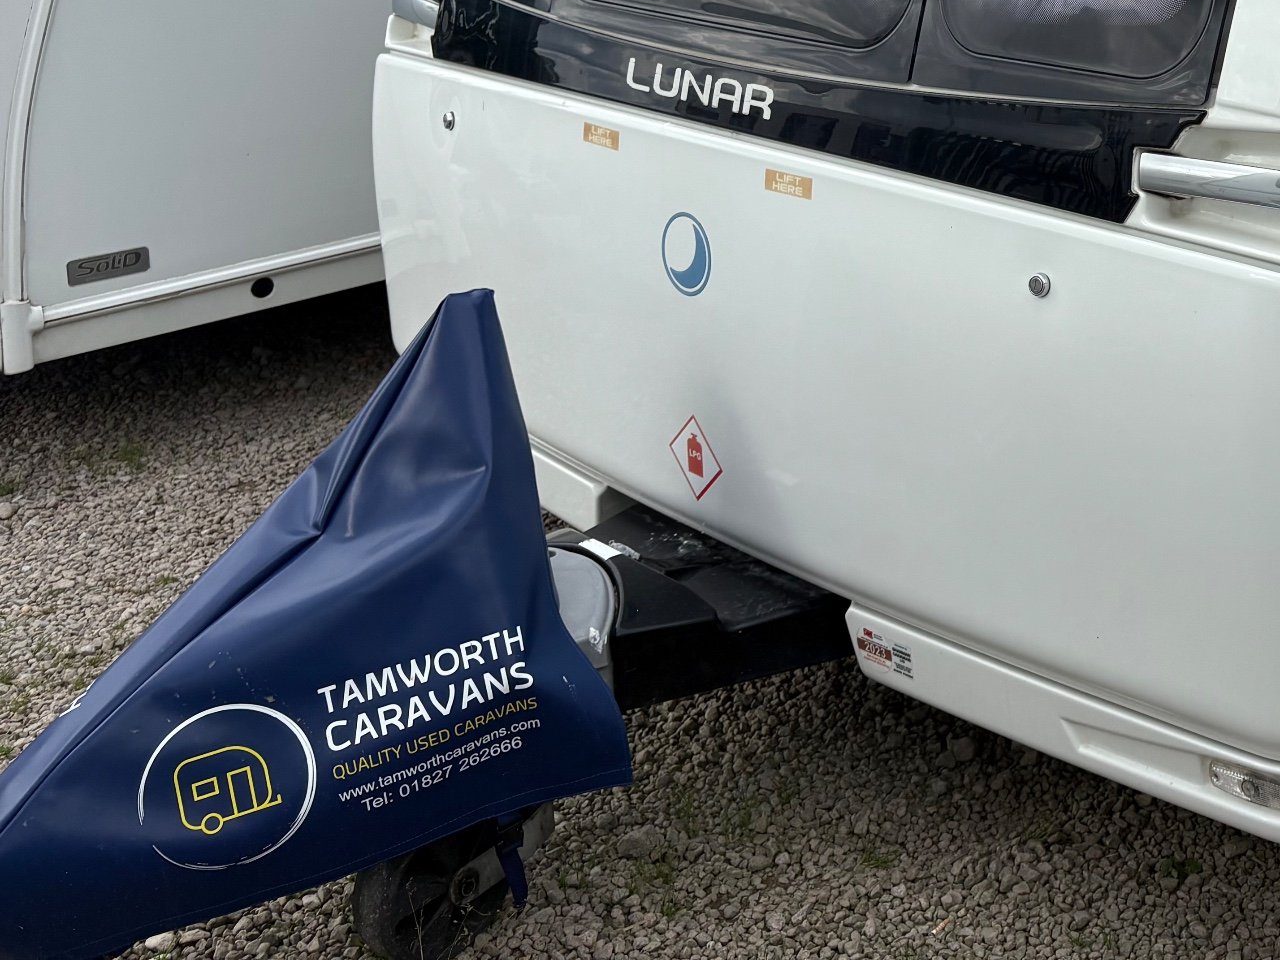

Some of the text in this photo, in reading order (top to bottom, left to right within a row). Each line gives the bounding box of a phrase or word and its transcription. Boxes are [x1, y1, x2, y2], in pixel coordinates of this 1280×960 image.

[626, 57, 775, 121] LUNAR
[772, 180, 803, 197] HERE
[776, 172, 802, 186] LIFT
[688, 448, 702, 461] LPG
[317, 625, 525, 714] TAMWORTH
[864, 641, 887, 659] 2023
[325, 661, 535, 752] CARAVANS
[332, 696, 538, 780] QUALITY USED CARAVANS
[338, 718, 541, 803] www.tamworthcaravans.com
[361, 735, 523, 812] Tel: 01827 262666
